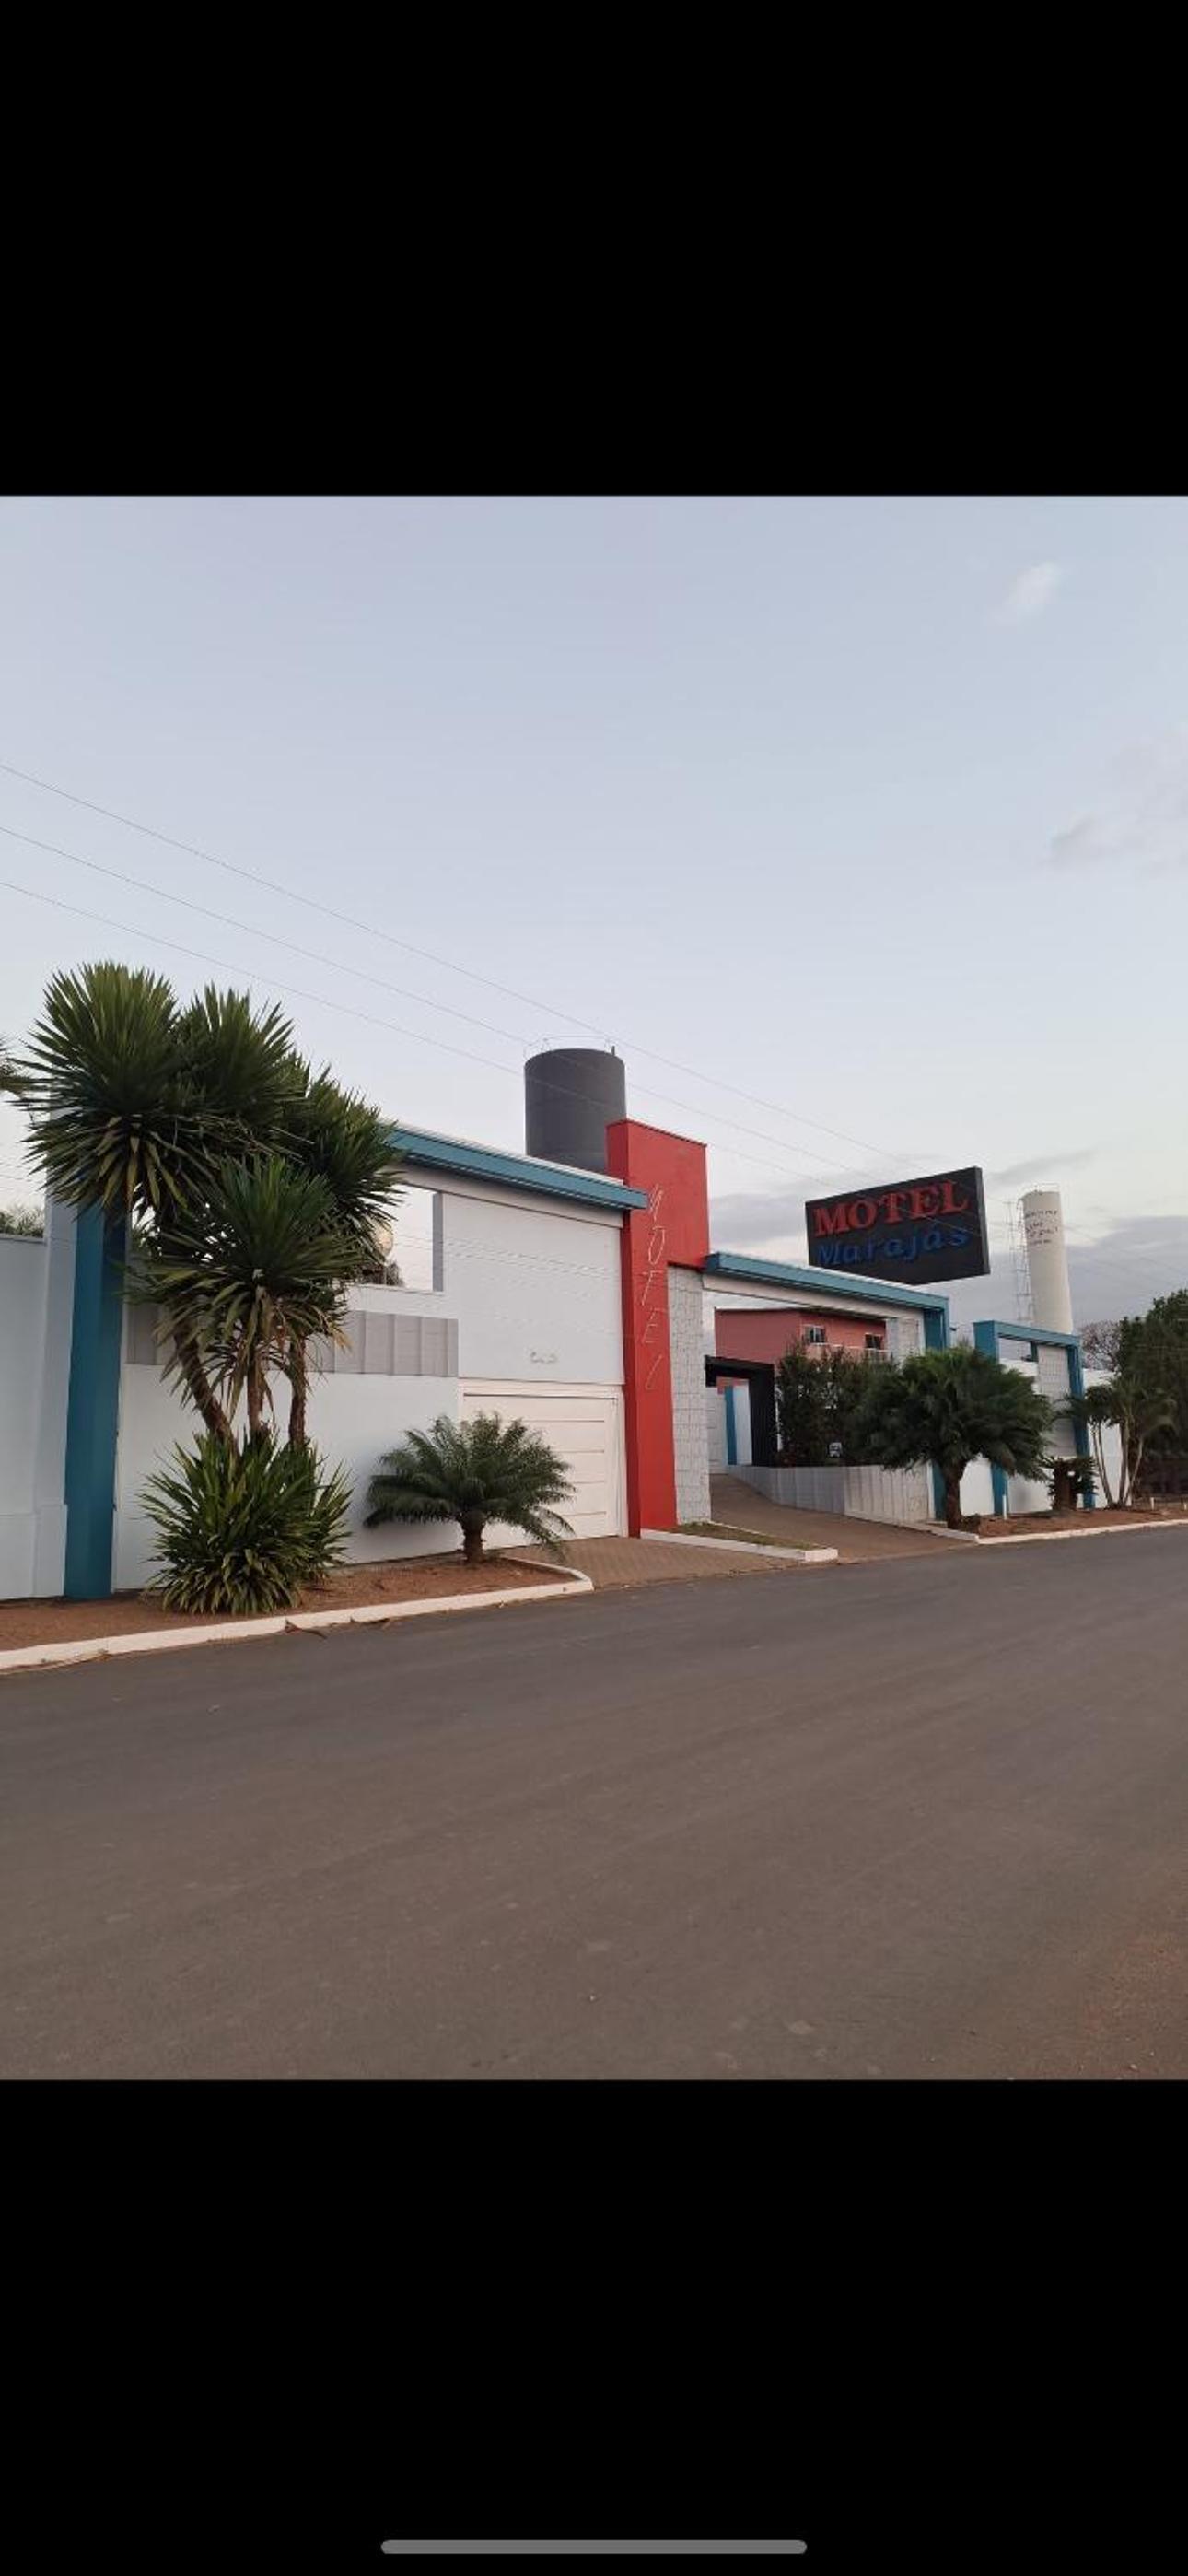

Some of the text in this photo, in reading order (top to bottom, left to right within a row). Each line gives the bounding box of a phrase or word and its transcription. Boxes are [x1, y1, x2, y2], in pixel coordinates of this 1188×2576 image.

[813, 1179, 969, 1237] MOTEL
[817, 1222, 972, 1266] Marajás
[641, 1183, 666, 1389] MOTEL
